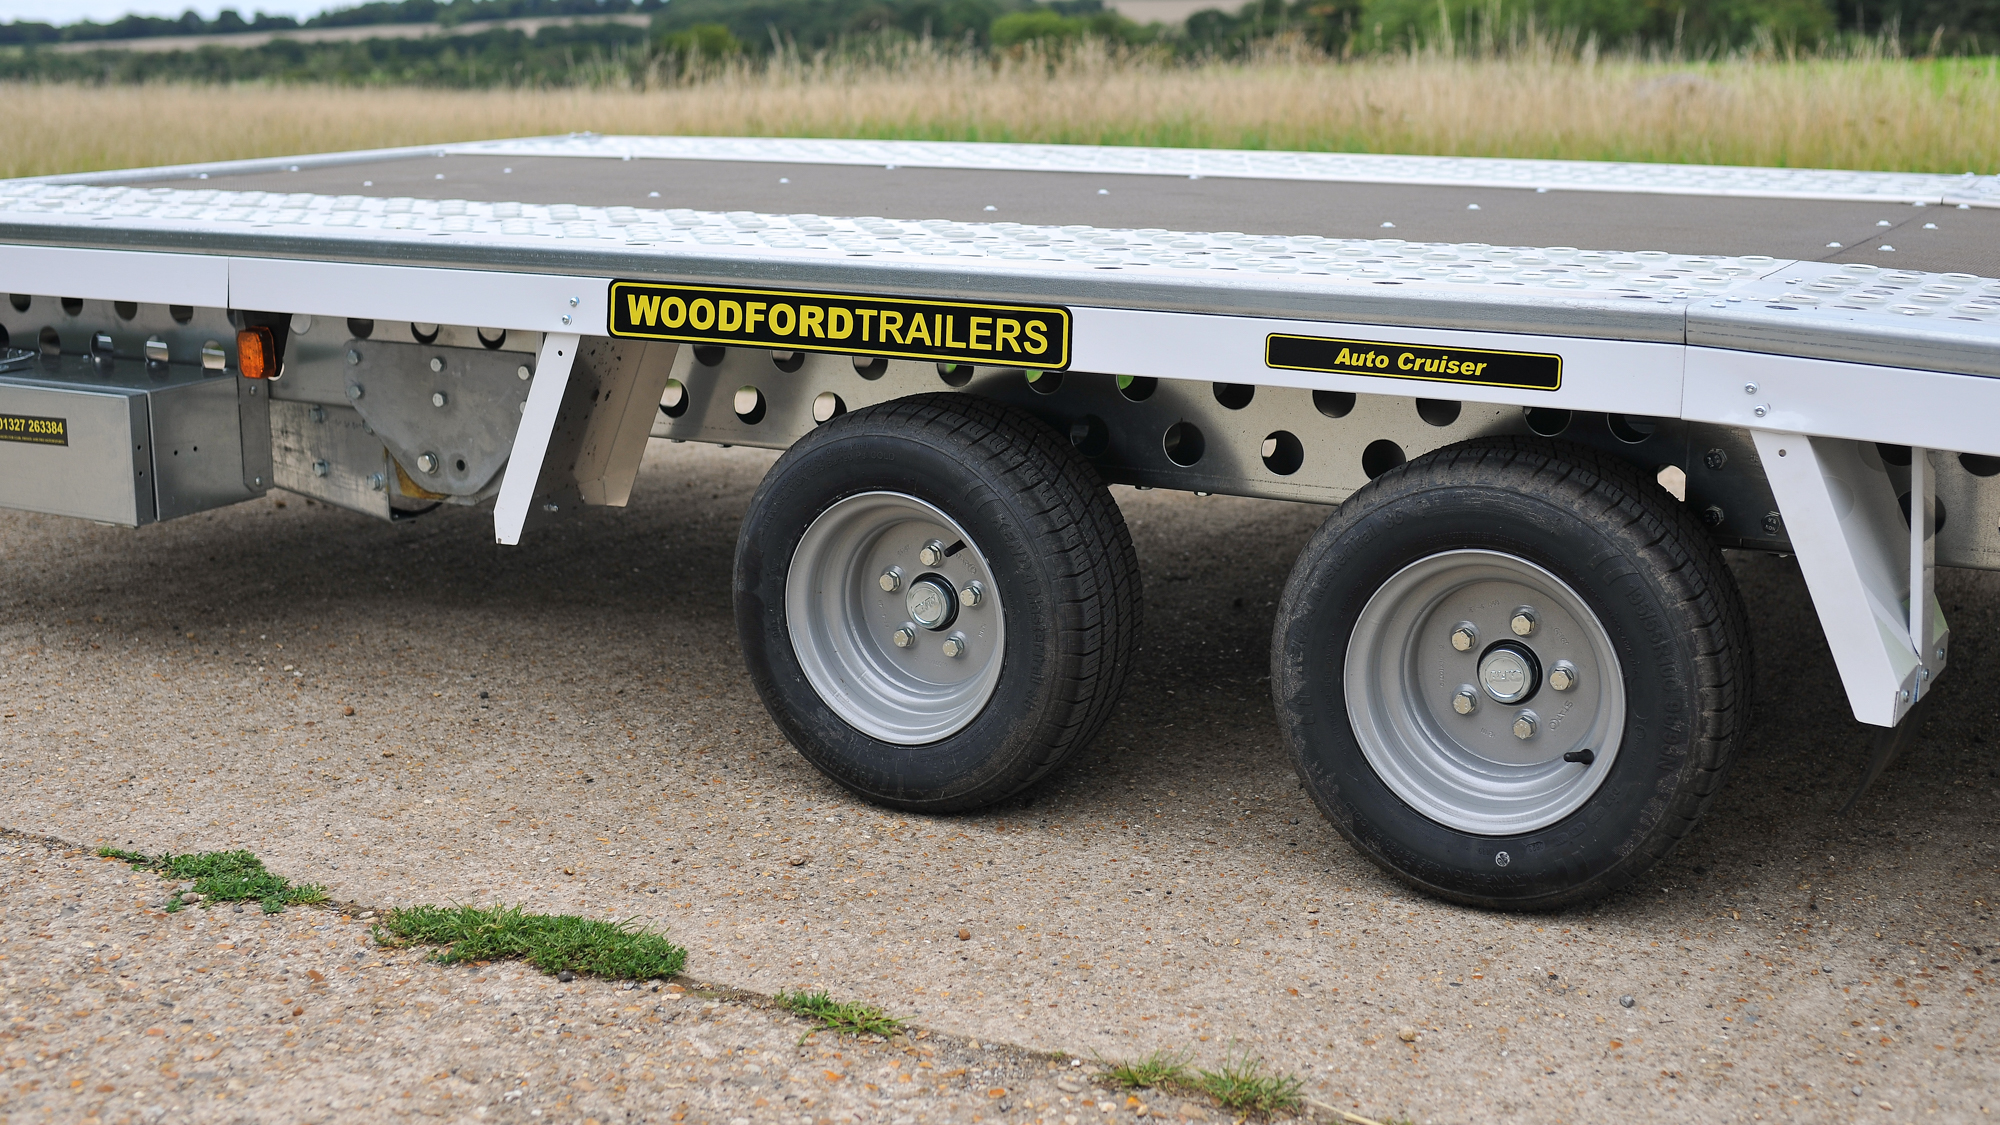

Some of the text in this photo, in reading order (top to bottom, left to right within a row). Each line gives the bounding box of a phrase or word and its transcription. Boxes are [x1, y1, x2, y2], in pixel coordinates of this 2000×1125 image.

[627, 294, 1048, 355] WOODFORDTRAILERS
[1334, 347, 1487, 376] Auto Cruiser
[0, 416, 64, 434] 01327 263384
[1305, 520, 1381, 603] MasterTrail
[1621, 579, 1680, 692] 195/55R10C
